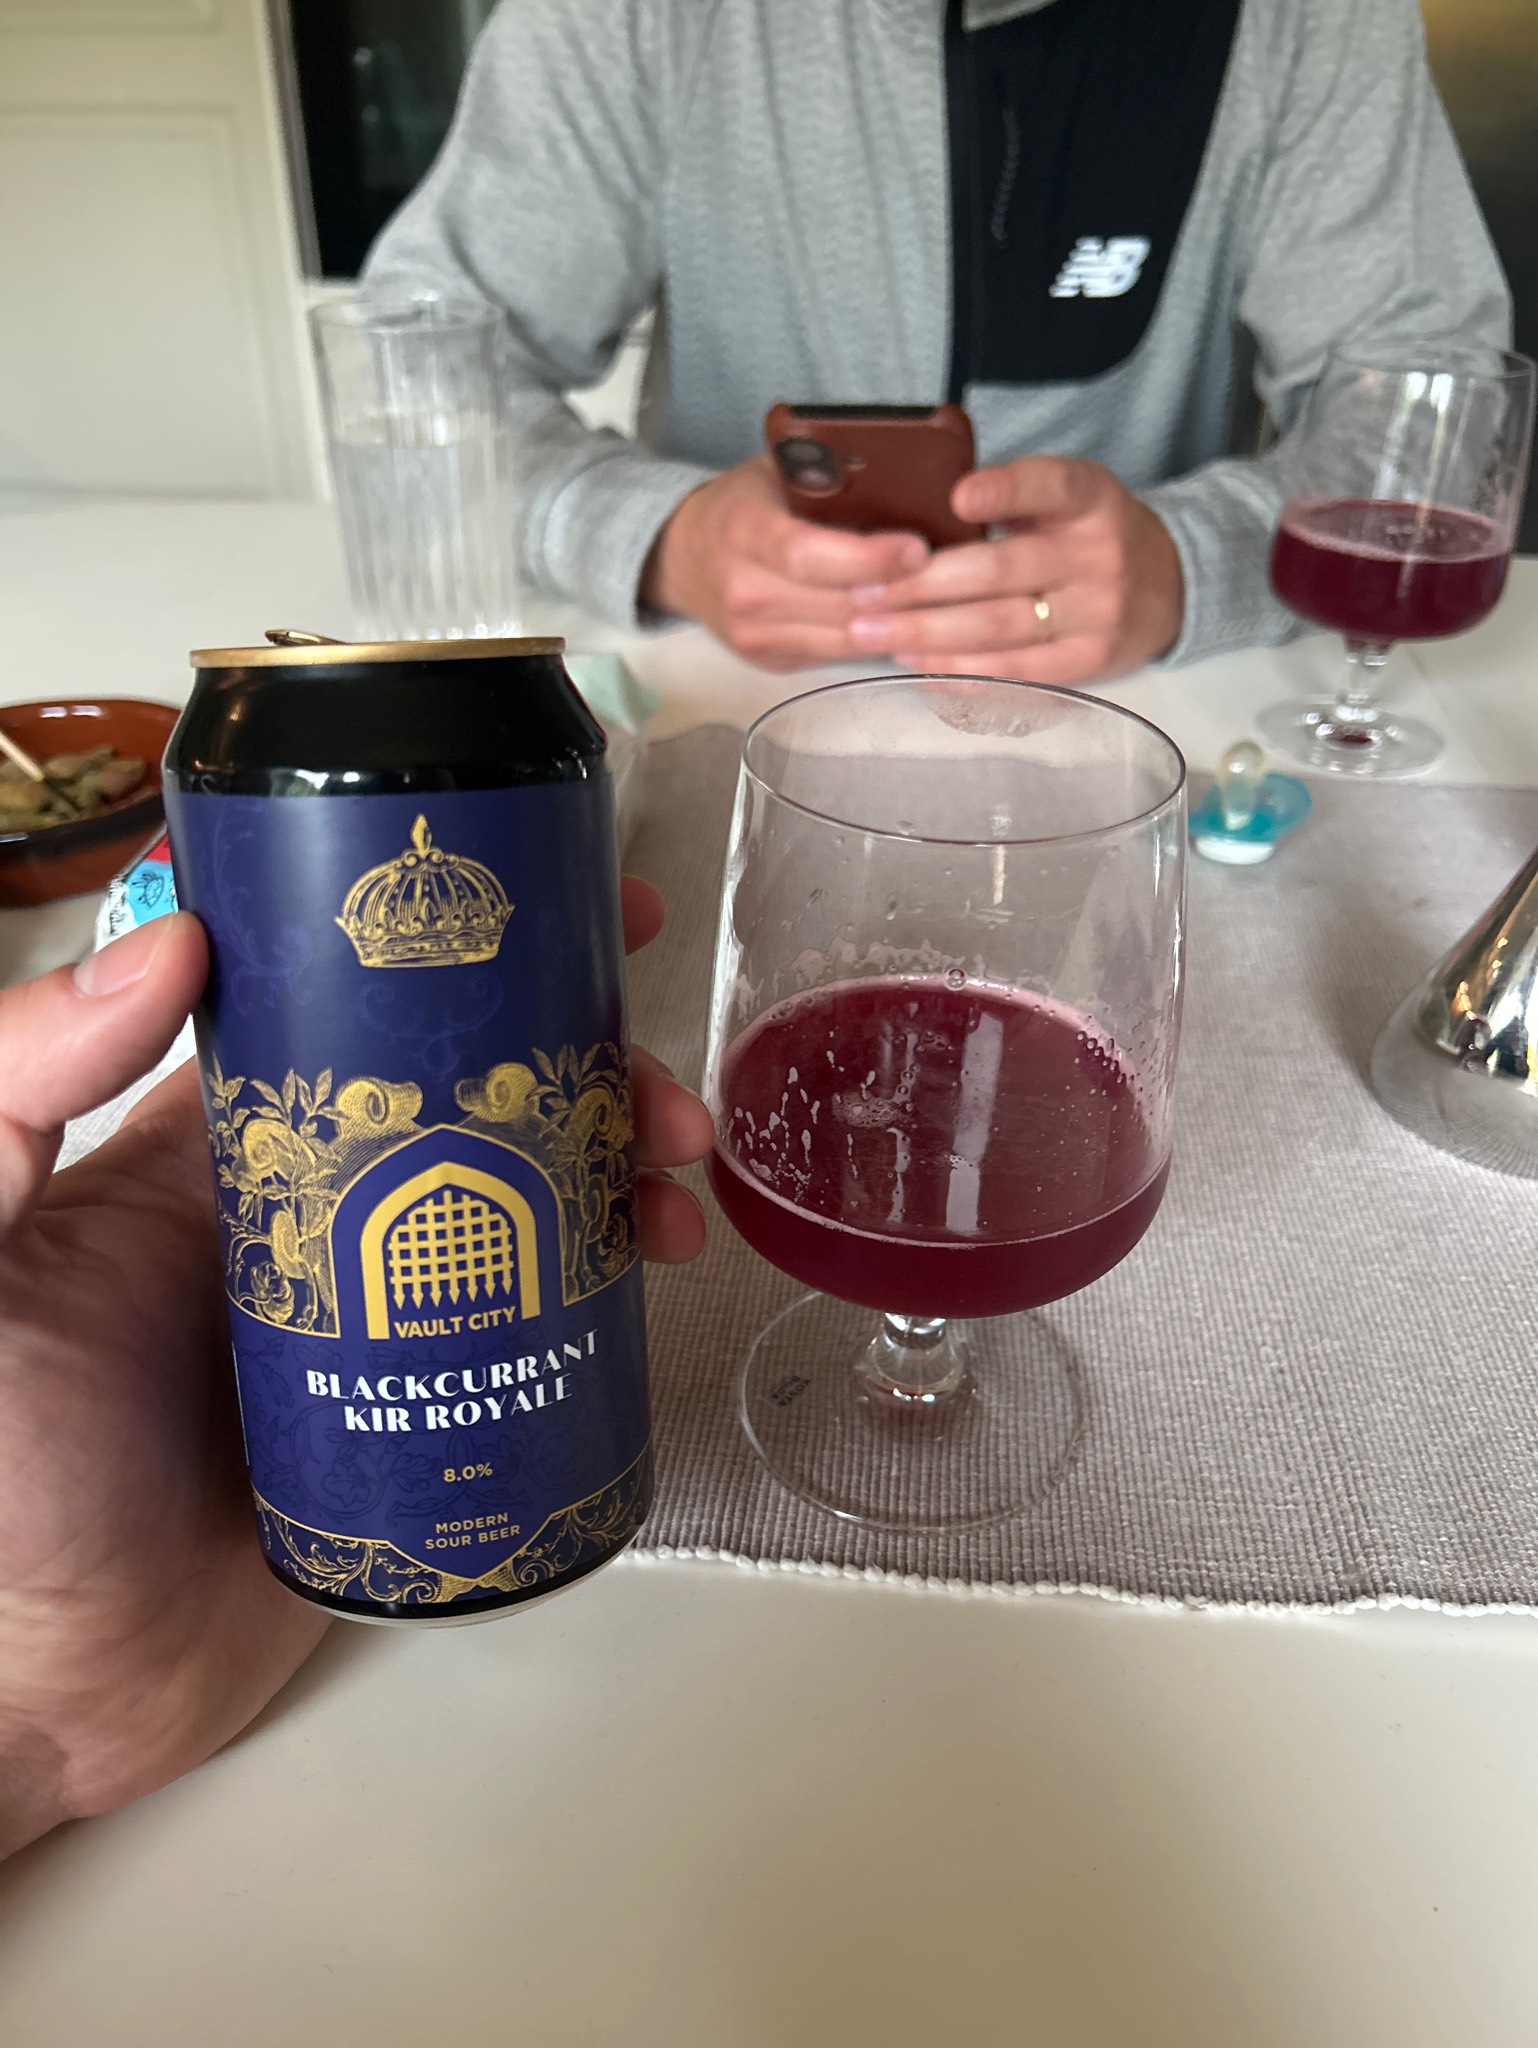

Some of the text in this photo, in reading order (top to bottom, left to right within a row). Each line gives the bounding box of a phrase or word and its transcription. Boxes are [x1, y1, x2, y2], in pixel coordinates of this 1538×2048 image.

[394, 1306, 517, 1339] VAULT CITY
[306, 1328, 599, 1401] BLACKCURRANT
[344, 1372, 574, 1432] KIR ROYALE
[443, 1462, 493, 1483] 8.0%
[424, 1524, 521, 1550] SOUR BEER
[435, 1512, 509, 1534] MODERN
